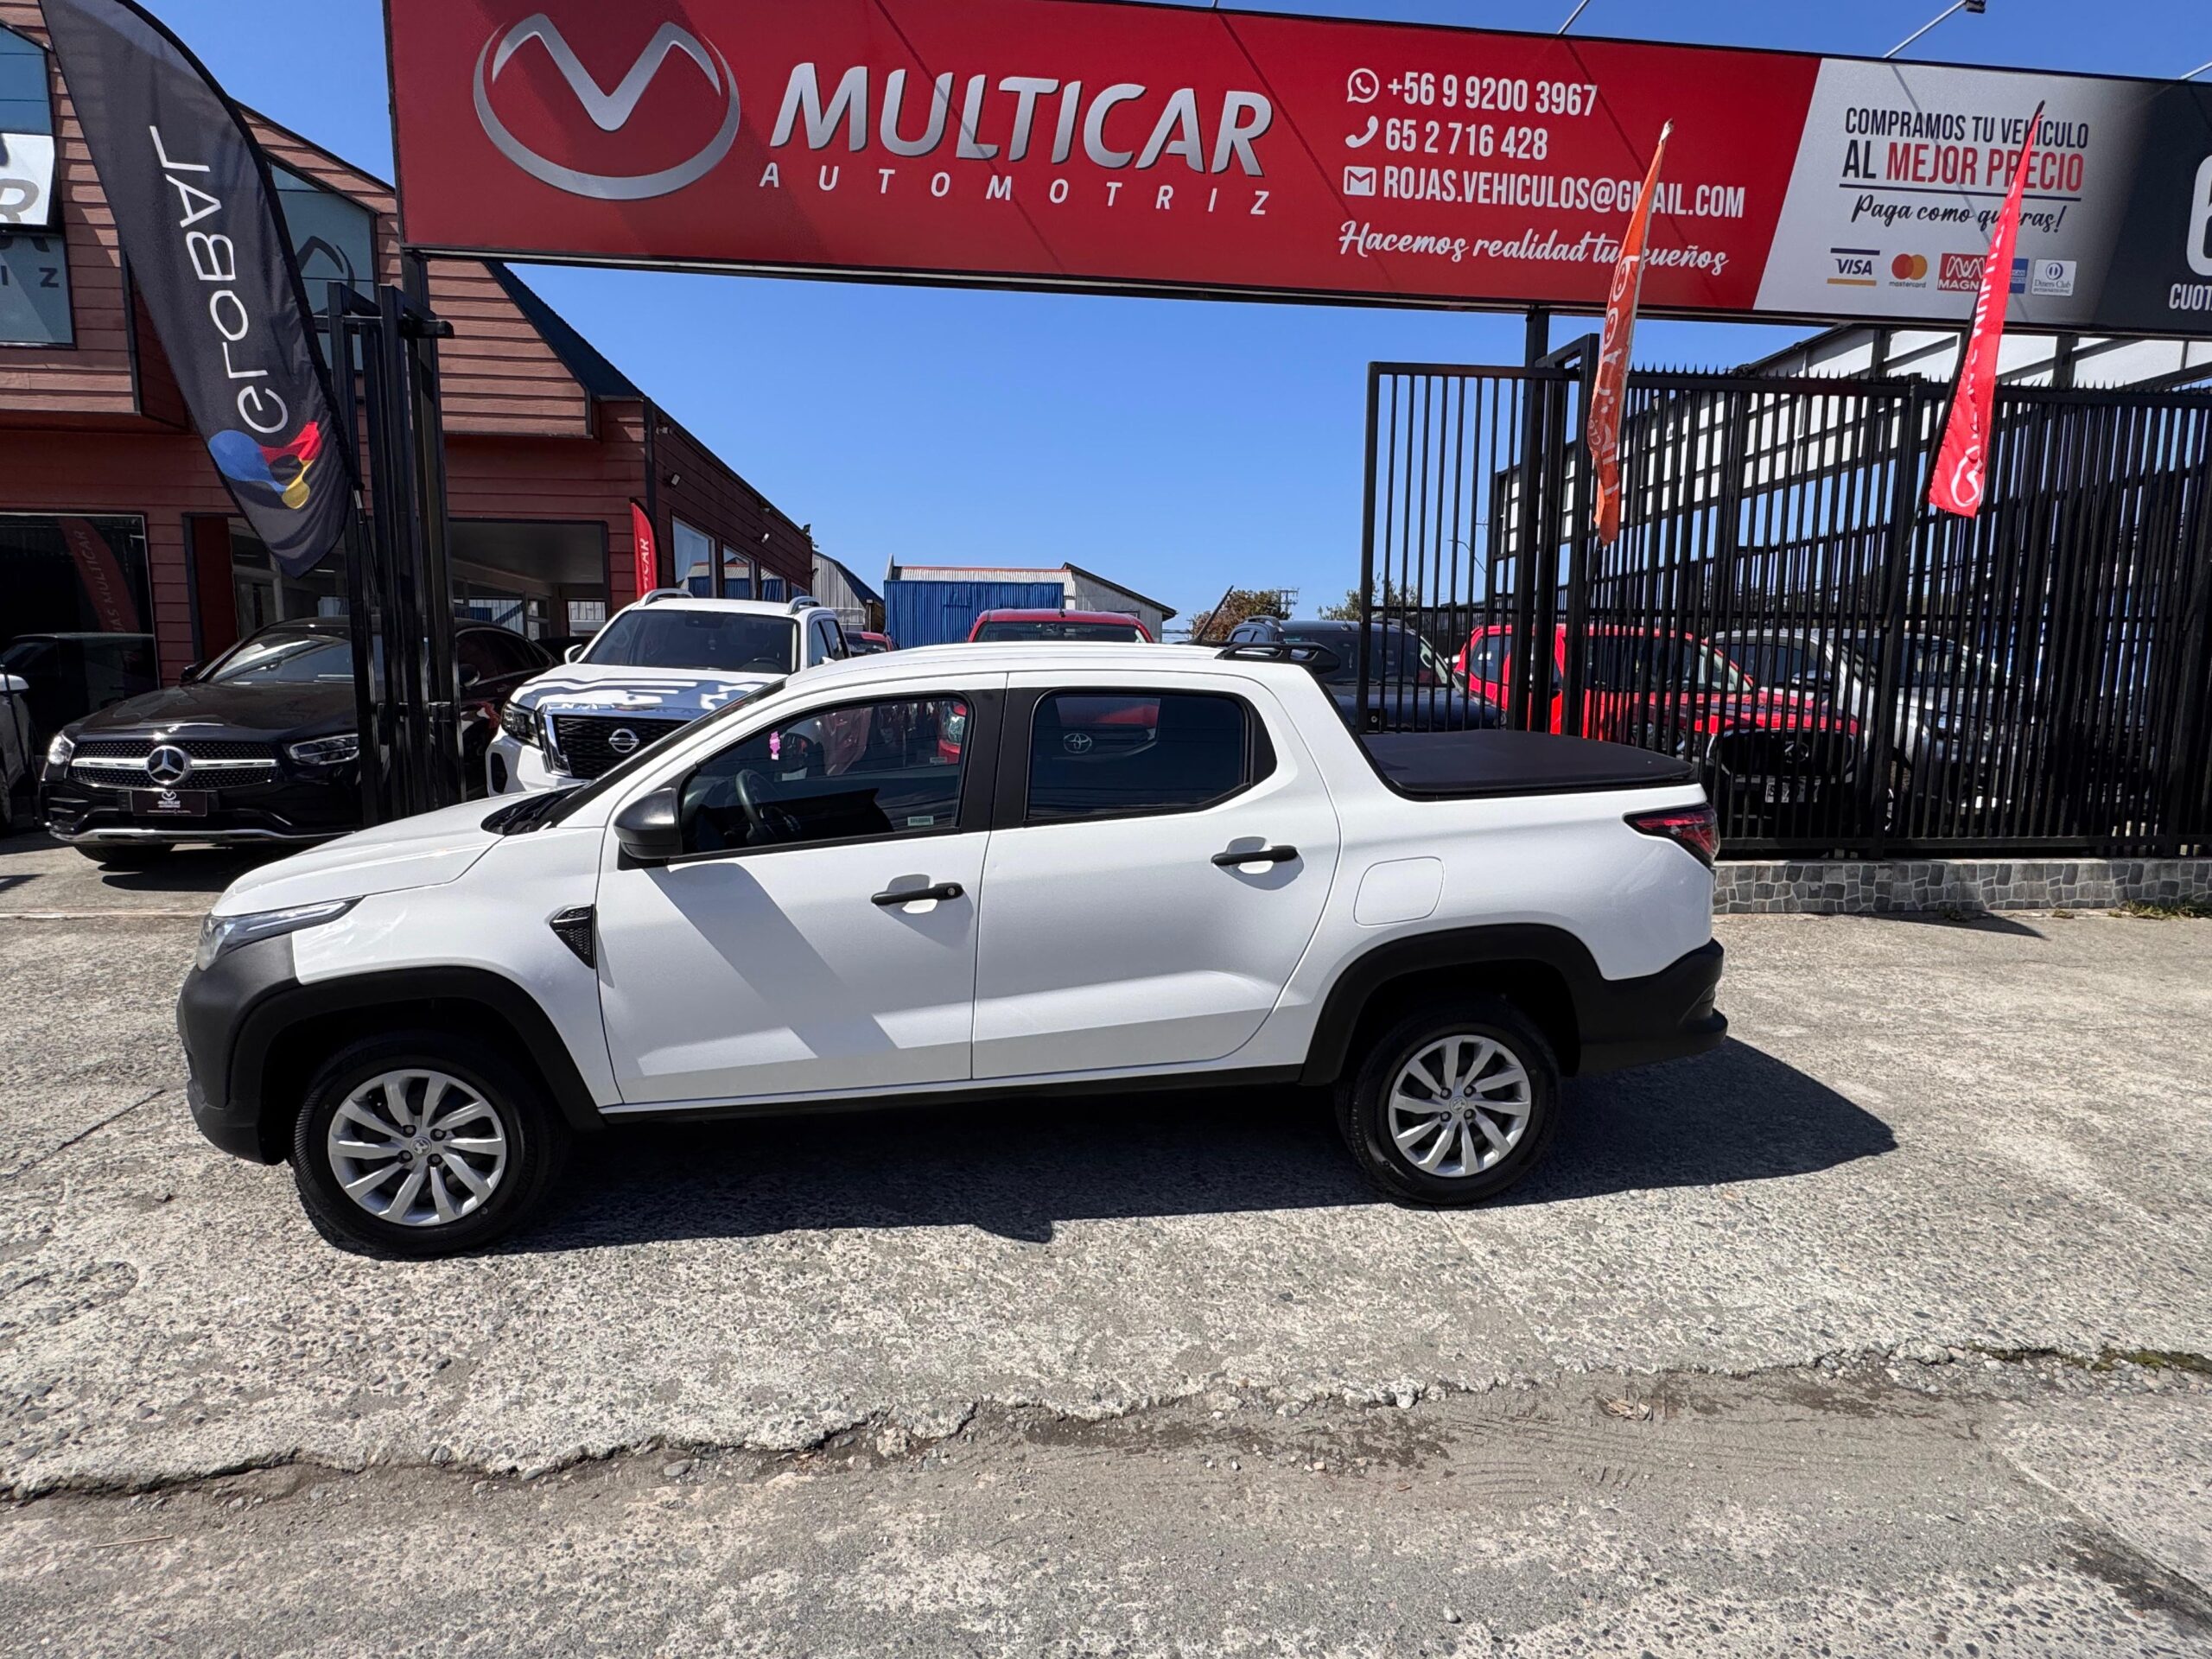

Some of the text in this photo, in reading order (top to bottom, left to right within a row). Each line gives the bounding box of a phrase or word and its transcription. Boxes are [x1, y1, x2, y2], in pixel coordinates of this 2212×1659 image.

[1388, 72, 1598, 116] +56 9 9200 3967
[769, 61, 1272, 177] MULTICAR
[1385, 118, 1548, 160] 65 2 716 428
[1845, 107, 1966, 141] COMPRAMOS
[1972, 116, 1996, 143] TU
[1841, 139, 2084, 192] AL MEJOR PRECIO
[759, 162, 1270, 215] AUTOMOTRIZ
[1851, 194, 2067, 232] Paga como quras!
[1338, 220, 1470, 263] Hacemos
[1472, 228, 1592, 261] realidad
[1588, 232, 1622, 264] tu
[1835, 258, 1873, 276] VISA
[1938, 278, 1980, 291] MAGN
[2169, 283, 2212, 311] CUOT
